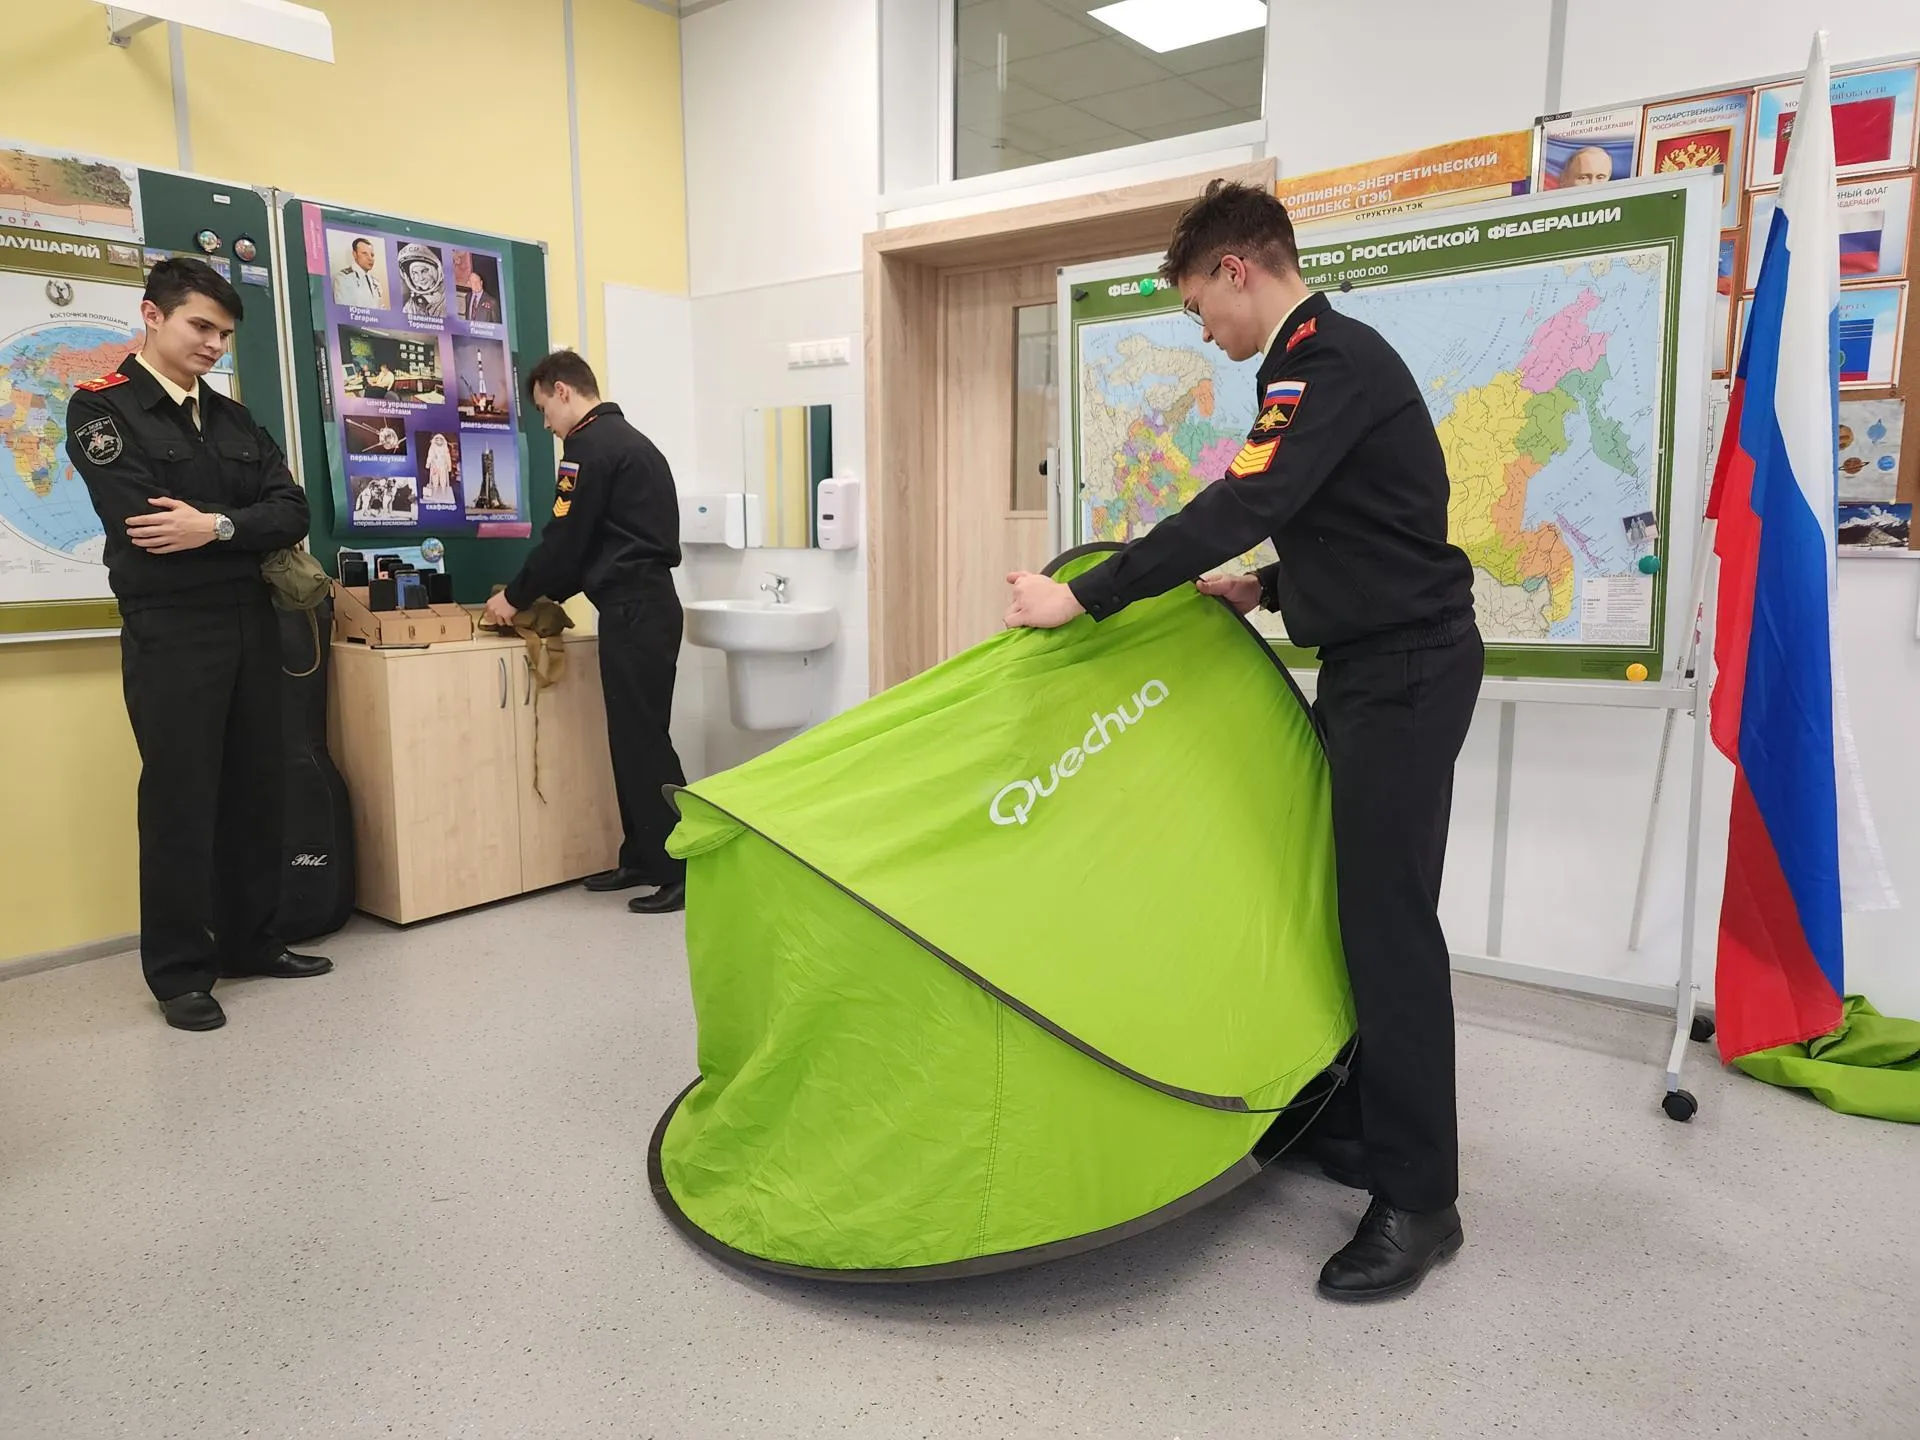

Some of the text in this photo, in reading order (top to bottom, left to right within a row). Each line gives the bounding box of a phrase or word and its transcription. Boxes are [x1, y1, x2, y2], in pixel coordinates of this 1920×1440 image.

[1649, 102, 1745, 123] ГОСУДАРСТВЕННЫЙ ГЕРБ
[1570, 115, 1613, 127] ПРЕЗИДЕНТ
[1594, 120, 1634, 132] ФЕДЕРАЦИИ
[1651, 113, 1739, 130] РОССИЙСКОЙ ФЕДЕРАЦИИ
[1280, 151, 1498, 207] ТОПЛИВНО-ЭНЕРГЕТИЧЕСКИЙ
[1864, 186, 1889, 196] ФЛАГ
[1355, 189, 1392, 209] (ТЭК)
[1355, 202, 1423, 221] СТРУКТУРА ТЭК
[1352, 226, 1480, 261] РОССИЙСКОЙ
[1487, 207, 1622, 240] ФЕДЕРАЦИИ
[1347, 268, 1366, 280] 000
[1368, 265, 1388, 276] 000
[349, 305, 370, 315] Юрий
[89, 313, 129, 327] ПОЛУШАРИЕ
[350, 313, 378, 323] Гагарин
[408, 314, 443, 324] Валентина
[408, 321, 445, 331] Терешкова
[387, 401, 428, 410] управления
[460, 422, 511, 430] ракета-носитель
[350, 454, 406, 464] первый спутник
[426, 503, 457, 511] скафандр
[989, 679, 1169, 825] Quechua
